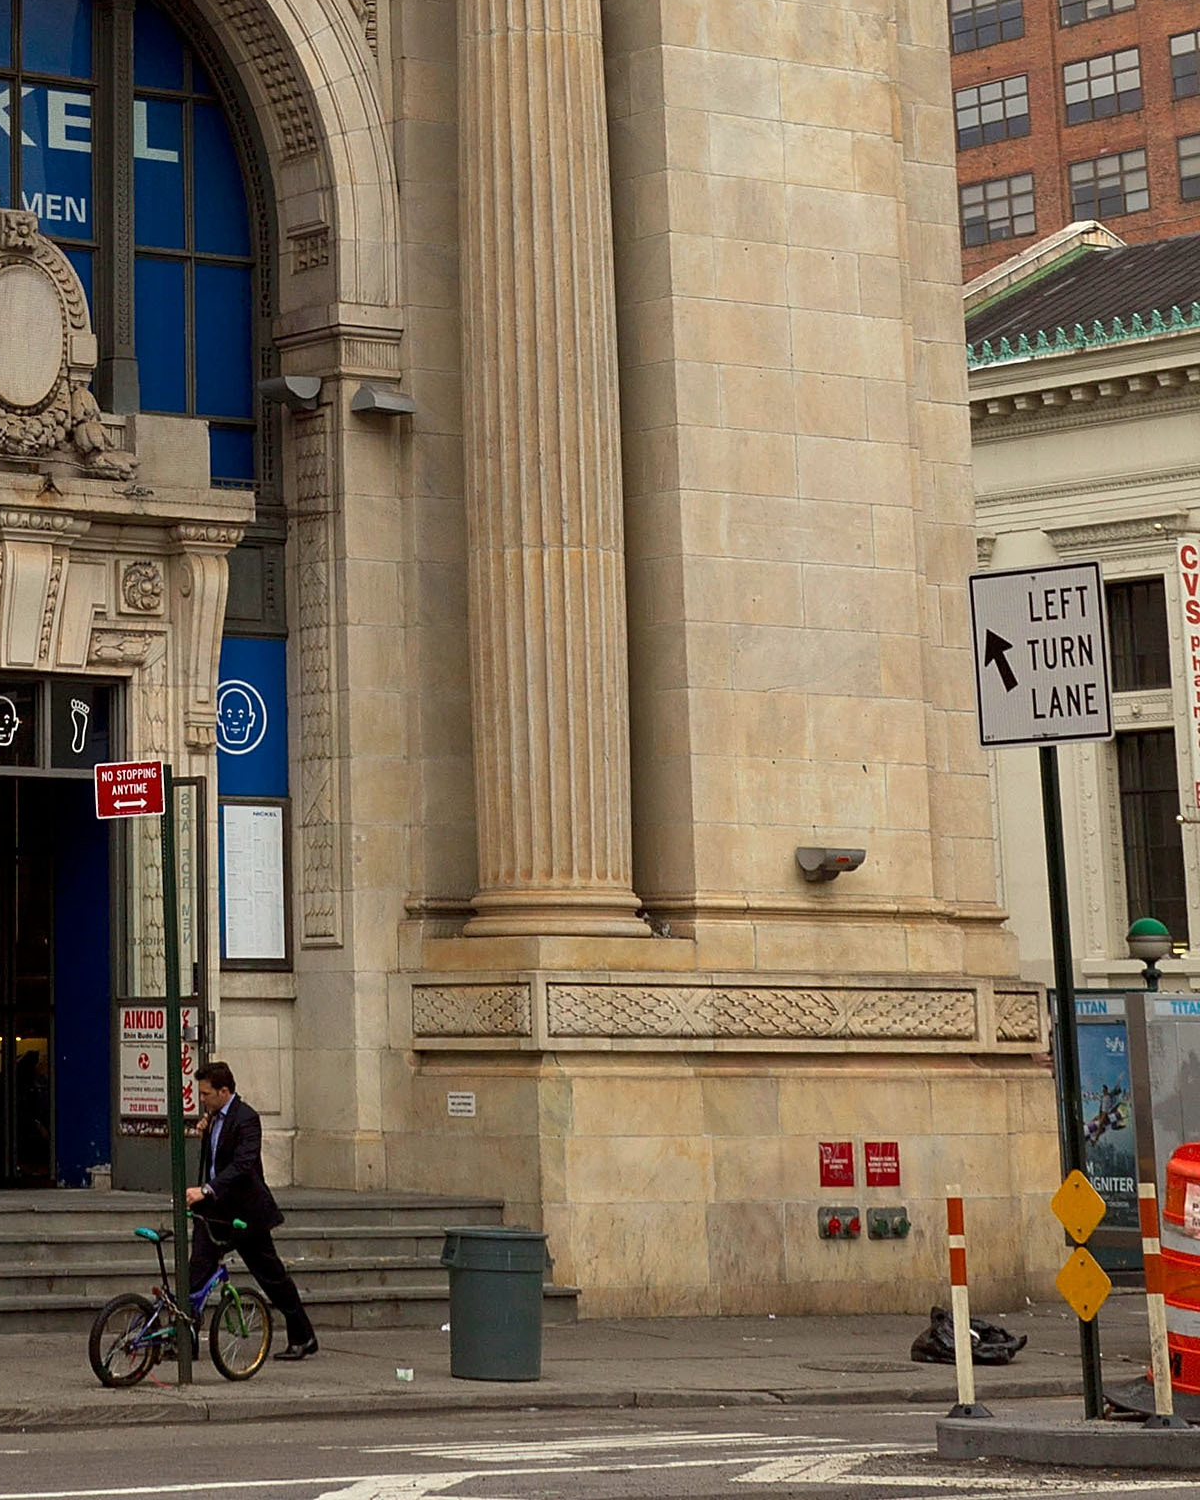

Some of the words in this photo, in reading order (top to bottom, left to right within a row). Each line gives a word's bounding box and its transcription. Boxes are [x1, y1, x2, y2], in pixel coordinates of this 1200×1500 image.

[1180, 545, 1200, 624] CVS
[1028, 586, 1088, 622] LEFT
[1027, 634, 1093, 671] TURN
[1032, 683, 1099, 719] LANE
[101, 771, 114, 782] NO
[116, 768, 157, 781] STOPPING
[111, 783, 148, 796] ANYTIME
[123, 1010, 164, 1029] AIKIDO
[1075, 1001, 1107, 1014] TITAN
